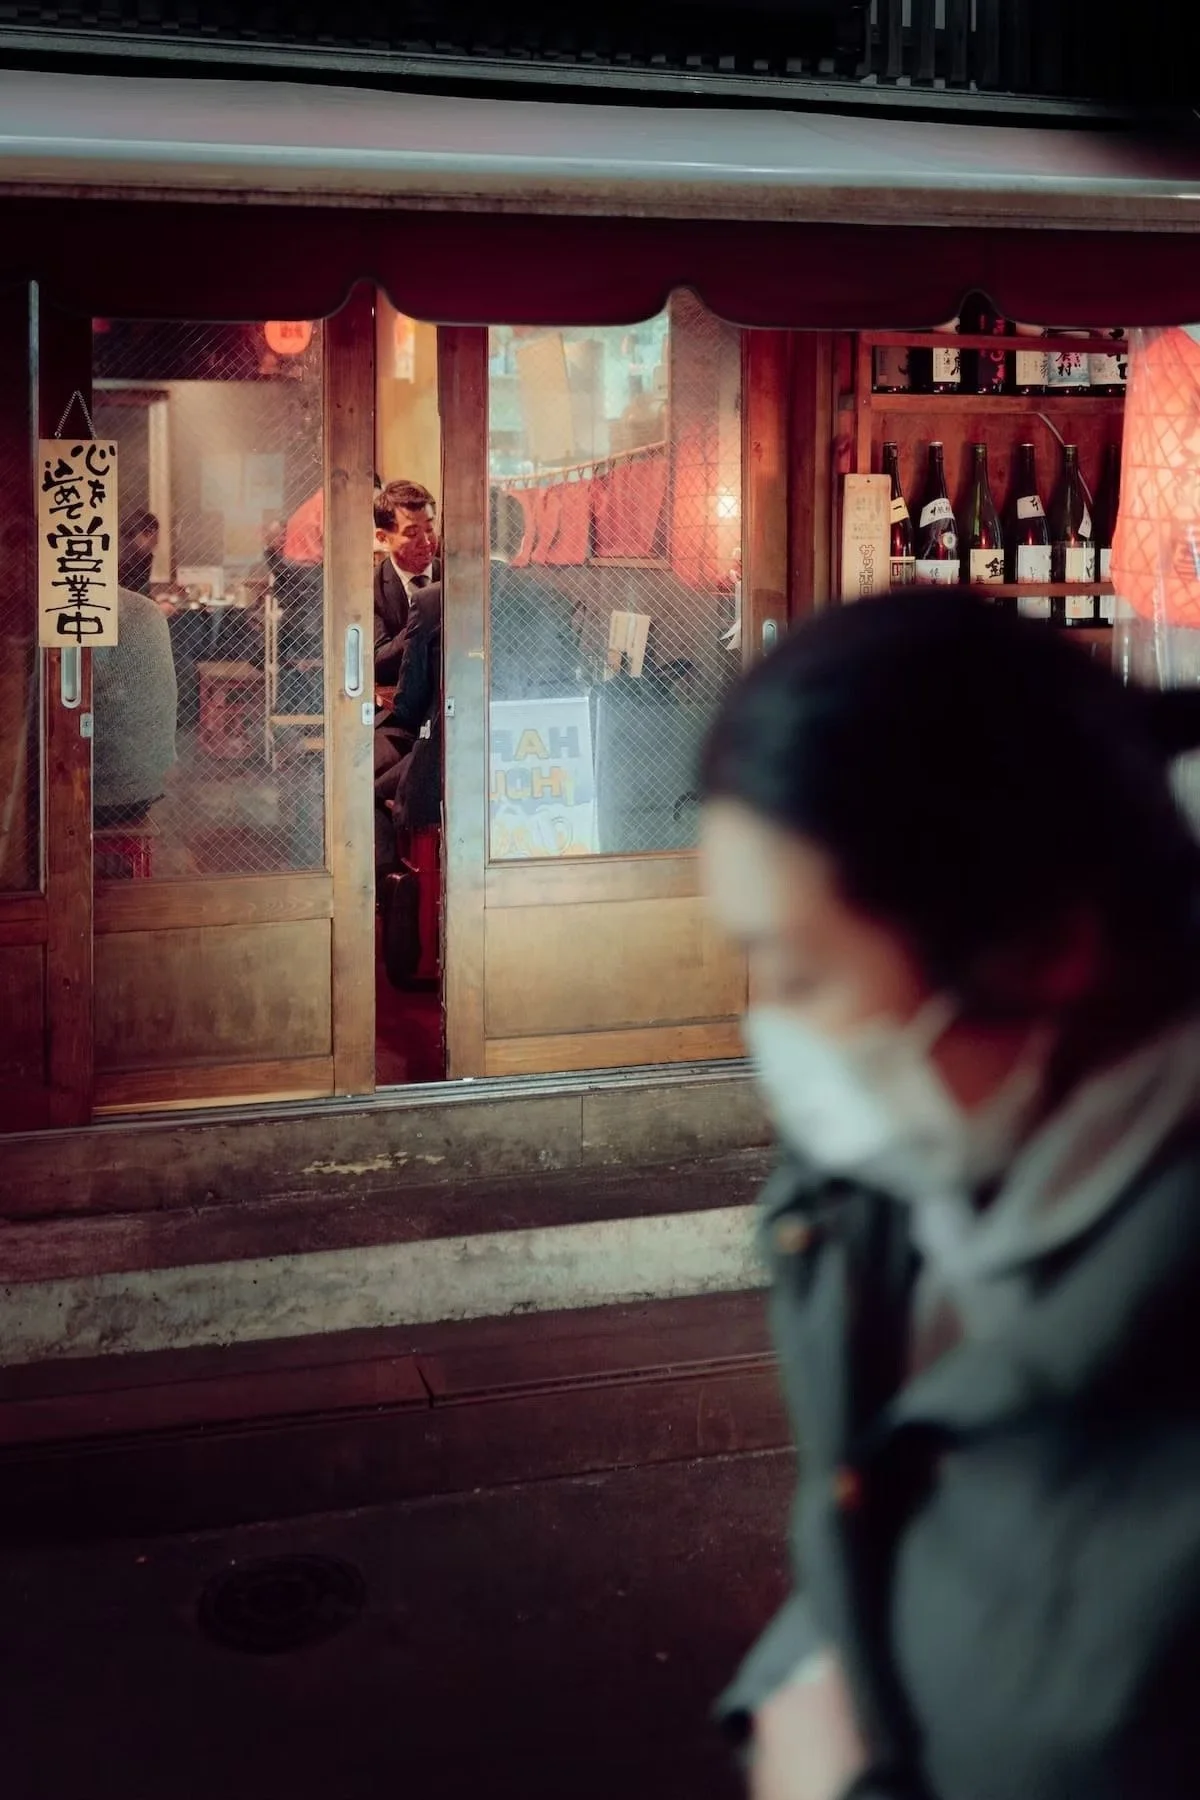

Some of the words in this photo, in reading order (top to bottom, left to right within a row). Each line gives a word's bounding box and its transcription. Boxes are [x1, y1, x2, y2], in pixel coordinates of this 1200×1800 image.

[71, 444, 116, 509] 心を
[45, 516, 111, 644] 営業中
